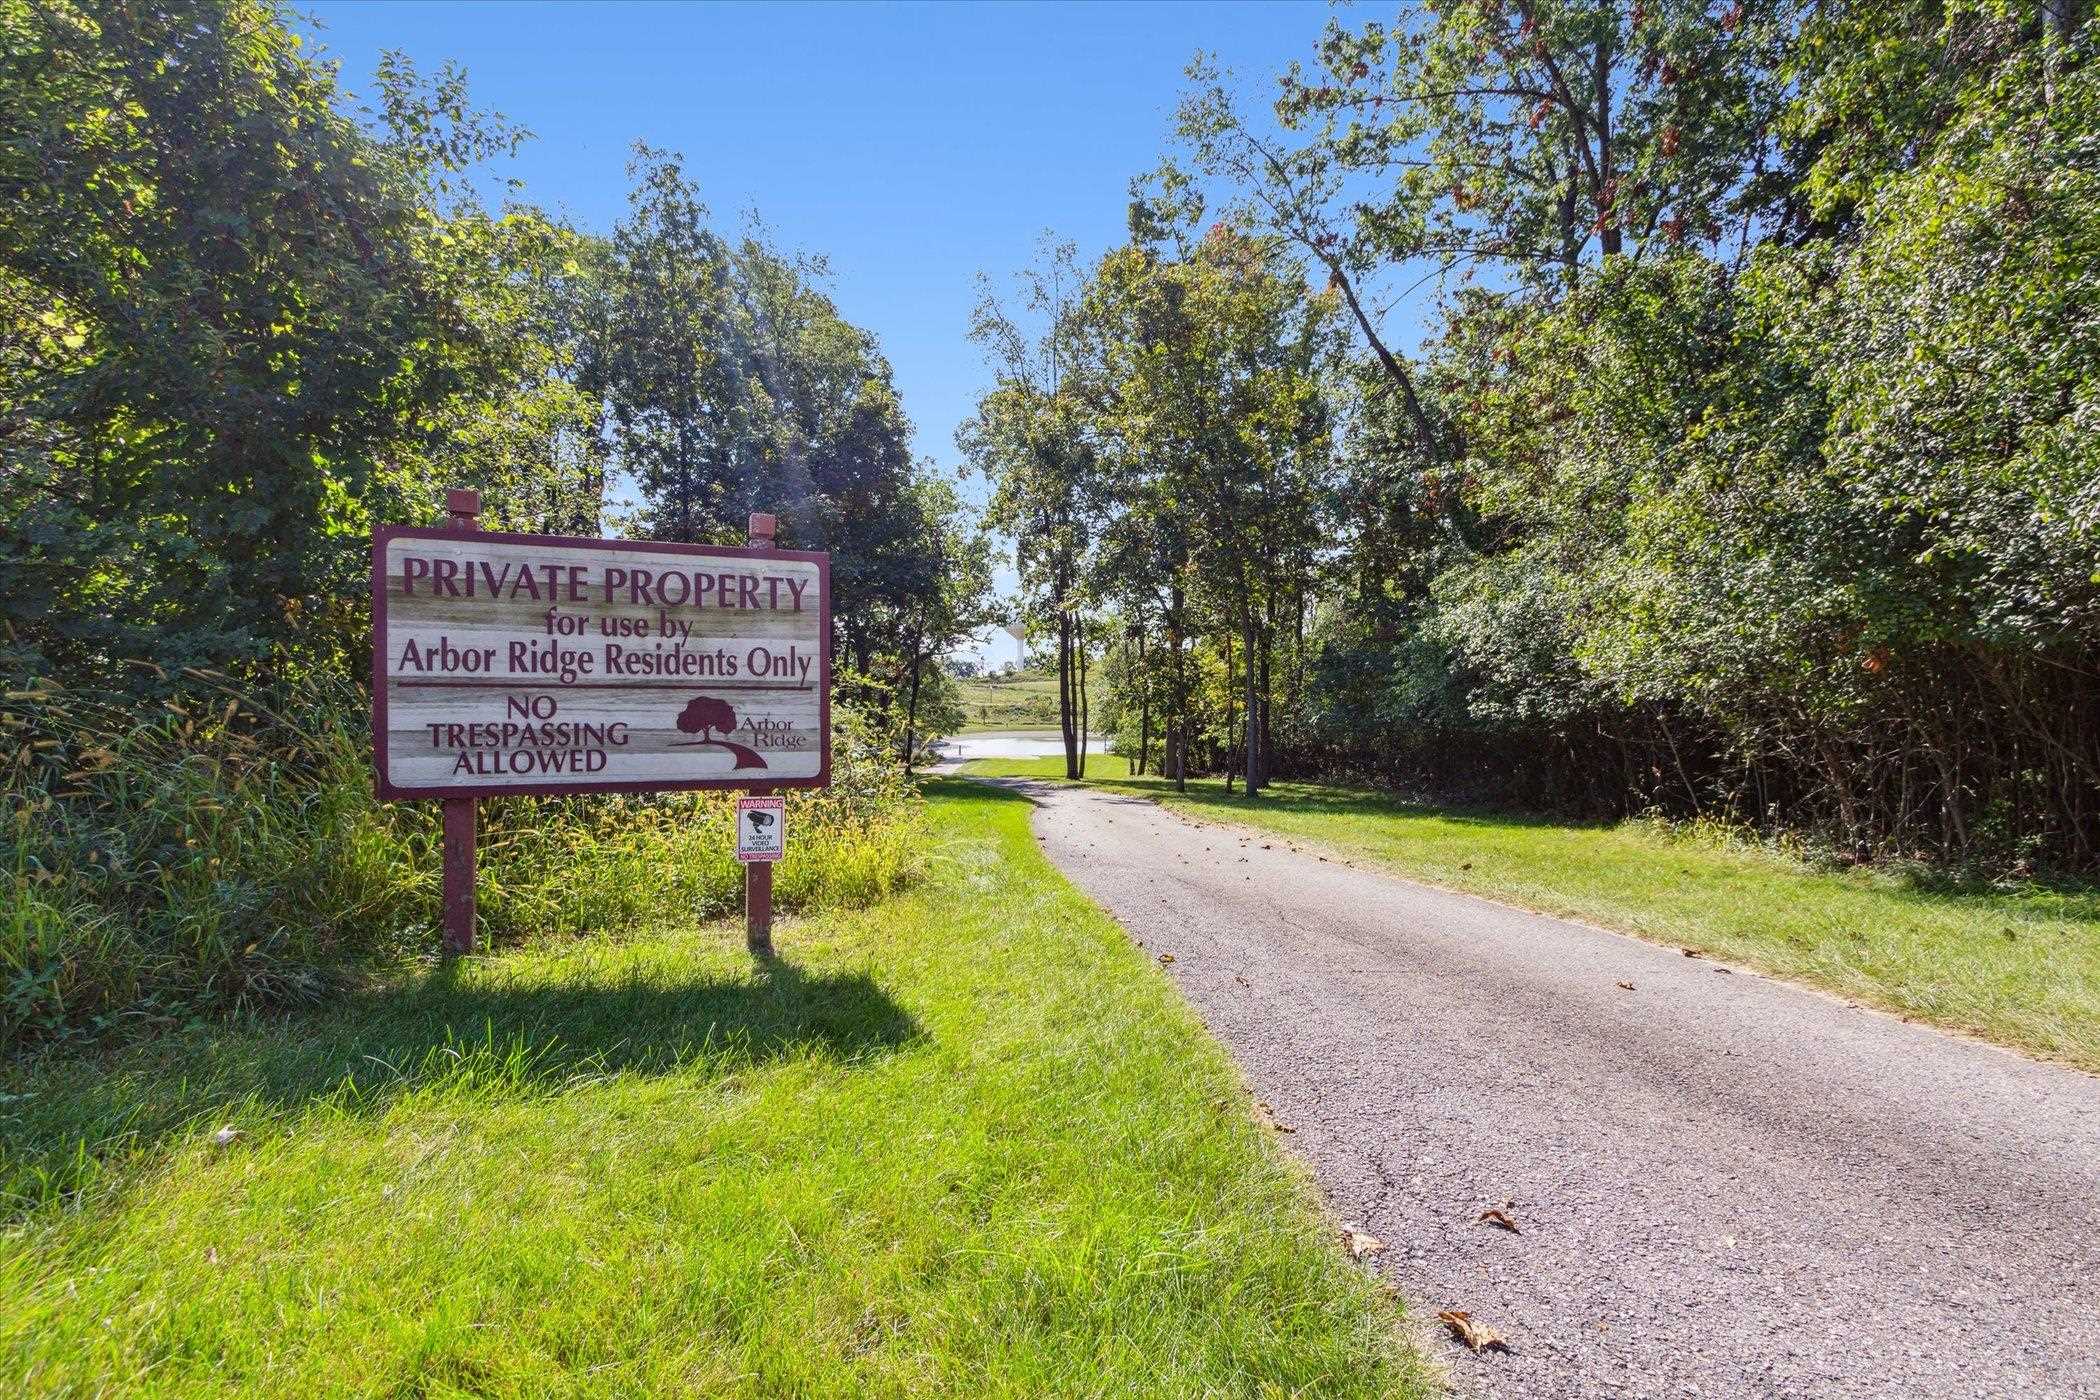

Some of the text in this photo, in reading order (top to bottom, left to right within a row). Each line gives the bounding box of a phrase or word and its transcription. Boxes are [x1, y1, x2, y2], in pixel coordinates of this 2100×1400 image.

[402, 557, 809, 612] PRIVATE PROPERTY
[545, 605, 693, 647] for use by
[399, 636, 811, 686] Arbor Ridge Residents Only
[507, 695, 558, 720] NO
[426, 722, 629, 748] TRESPASSING
[741, 713, 793, 731] Arbor
[752, 731, 807, 750] Ridge
[452, 749, 607, 775] ALLOWED
[740, 799, 783, 809] WARNING
